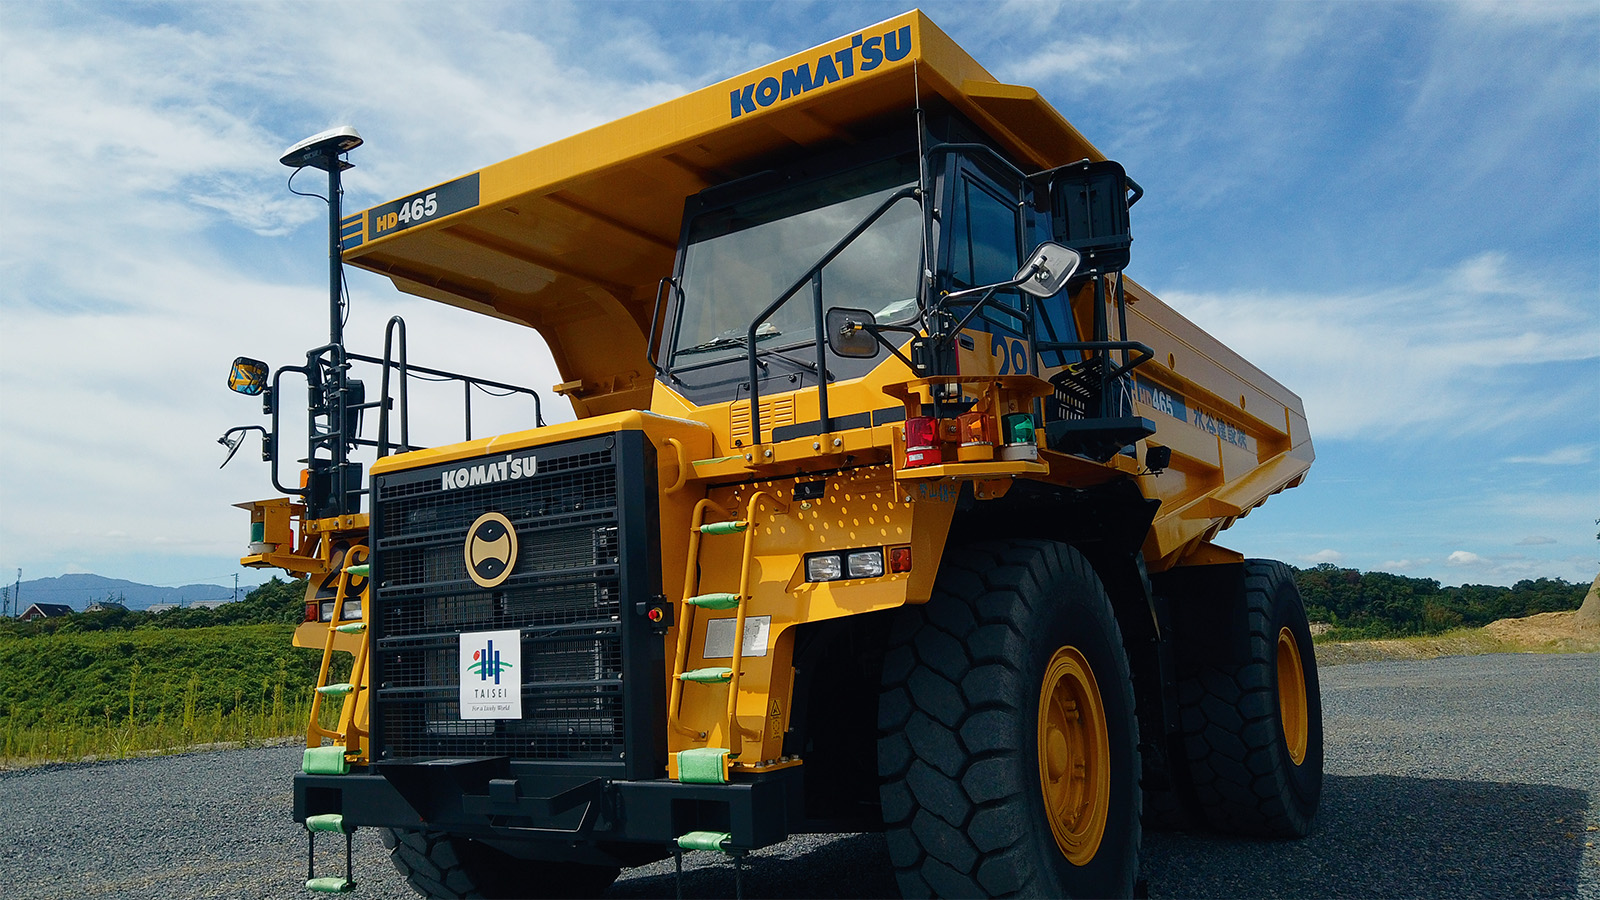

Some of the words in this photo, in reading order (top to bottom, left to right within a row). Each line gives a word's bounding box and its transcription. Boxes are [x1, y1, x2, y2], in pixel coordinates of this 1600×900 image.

[730, 25, 912, 119] KOMATSU
[376, 192, 438, 233] HD465
[442, 454, 537, 491] KOMATSU
[474, 688, 507, 698] TAISEI
